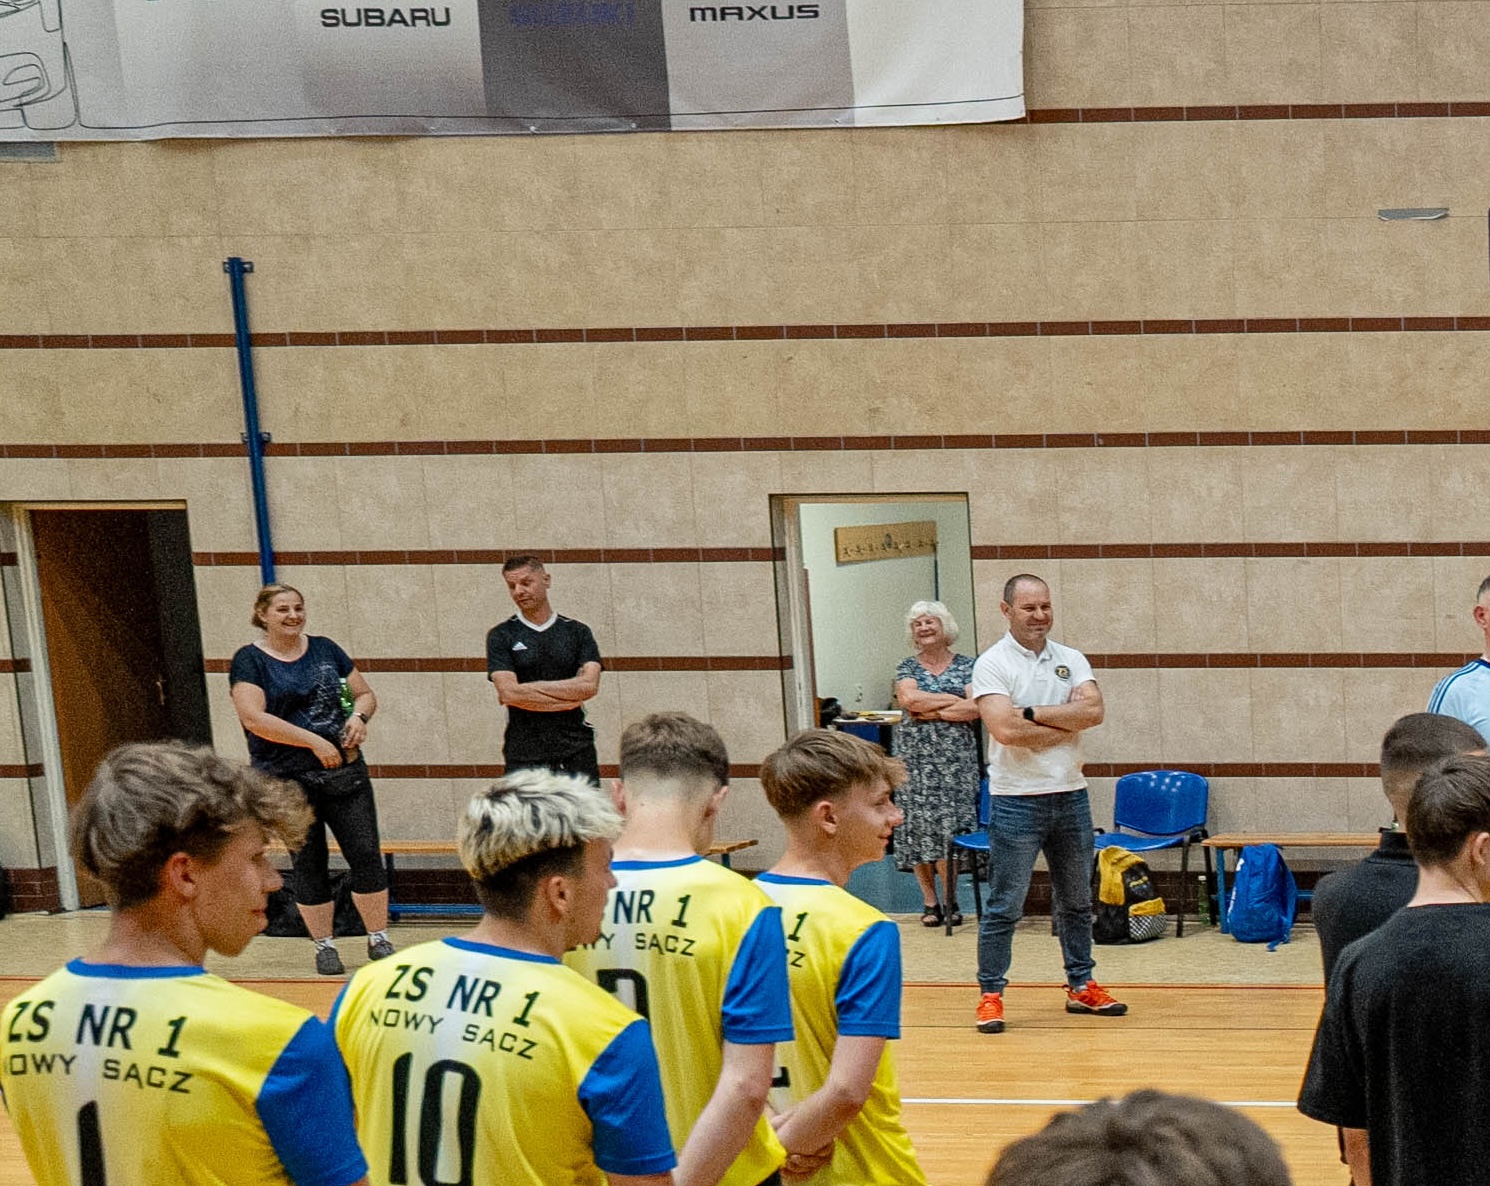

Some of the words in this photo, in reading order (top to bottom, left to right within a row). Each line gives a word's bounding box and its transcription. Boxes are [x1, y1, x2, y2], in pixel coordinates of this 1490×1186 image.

[320, 8, 452, 28] SUBARU
[689, 5, 821, 22] MAXUS
[613, 889, 655, 924] NR
[671, 894, 692, 929] 1
[787, 911, 809, 942] 1
[385, 965, 434, 1002] ZS
[447, 975, 502, 1018] NR
[513, 991, 540, 1028] 1
[8, 1000, 55, 1043] ZS
[75, 1004, 138, 1050] NR
[157, 1016, 188, 1059] 1
[370, 1009, 445, 1035] NOWY
[4, 1052, 78, 1076] OWY
